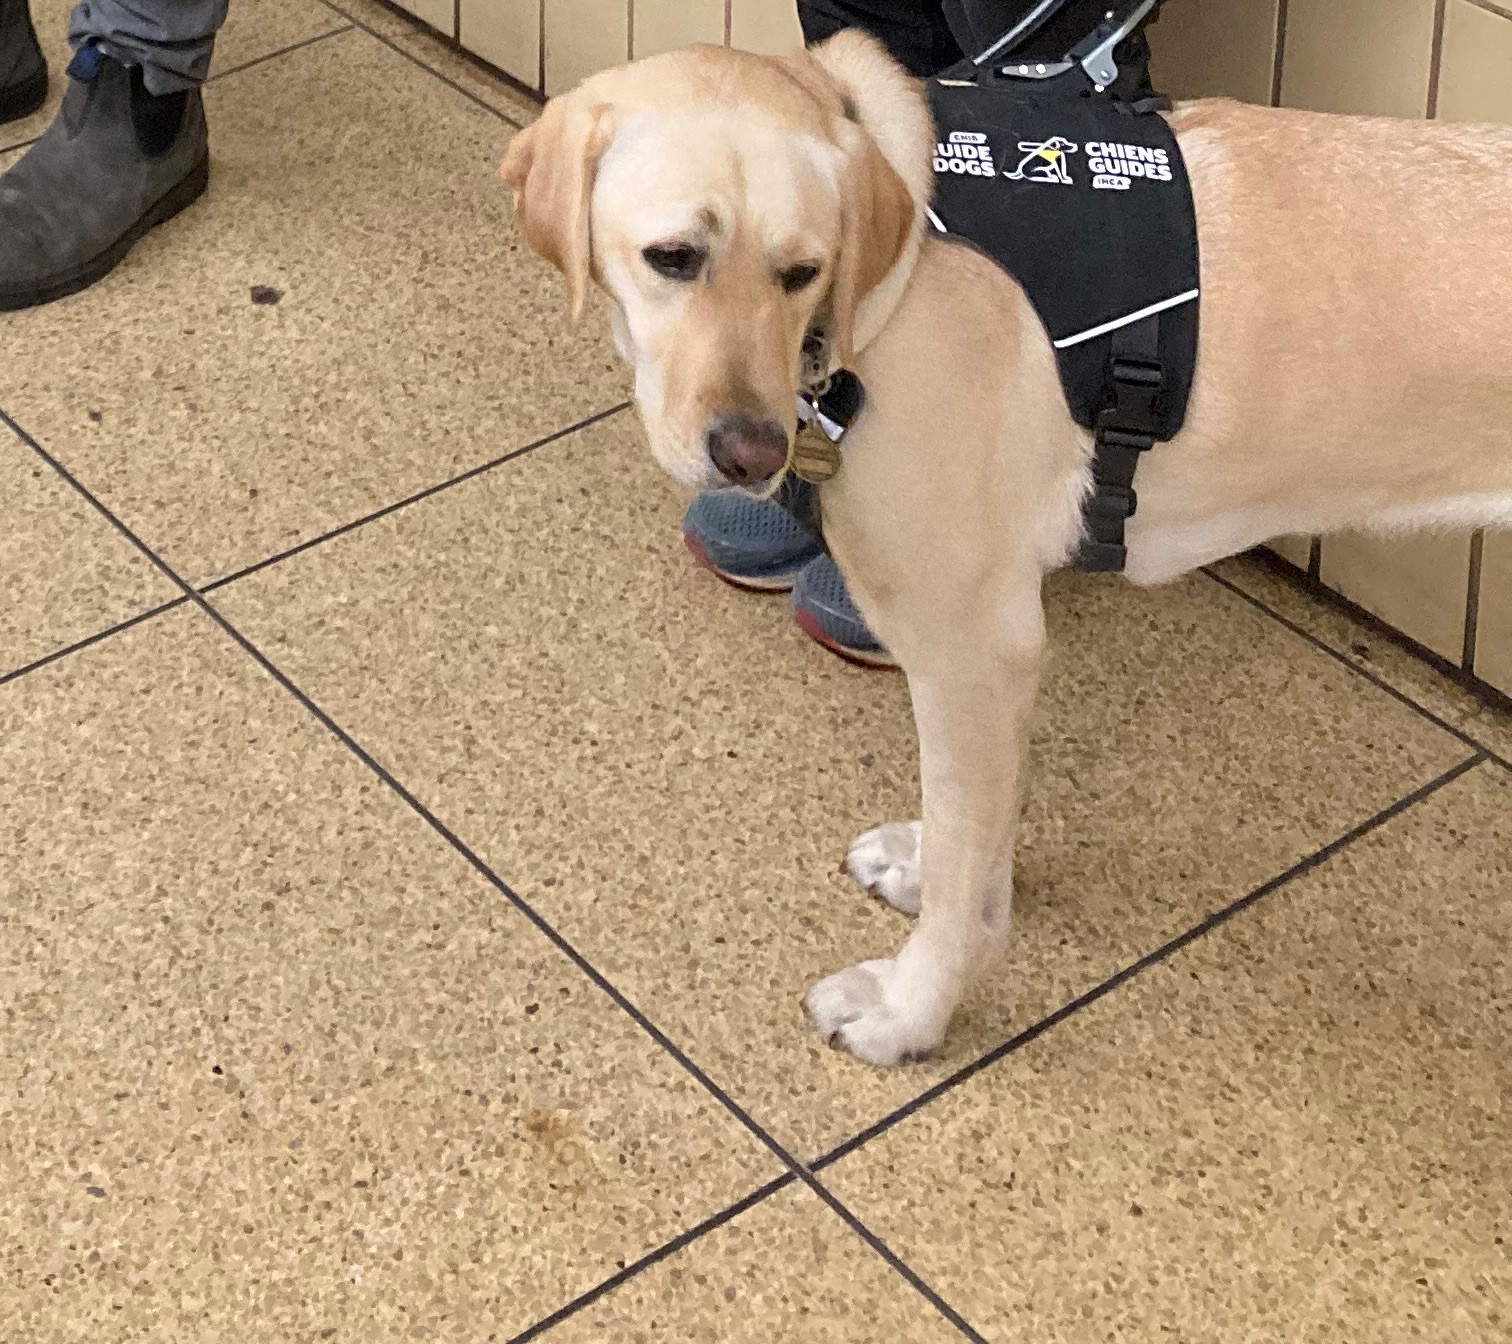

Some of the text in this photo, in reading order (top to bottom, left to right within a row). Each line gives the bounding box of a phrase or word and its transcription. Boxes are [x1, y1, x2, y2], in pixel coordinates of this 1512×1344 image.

[933, 143, 994, 161] UIDE
[1085, 141, 1169, 165] CHIENS
[933, 158, 997, 178] DOGS
[1088, 157, 1173, 182] GUIDES
